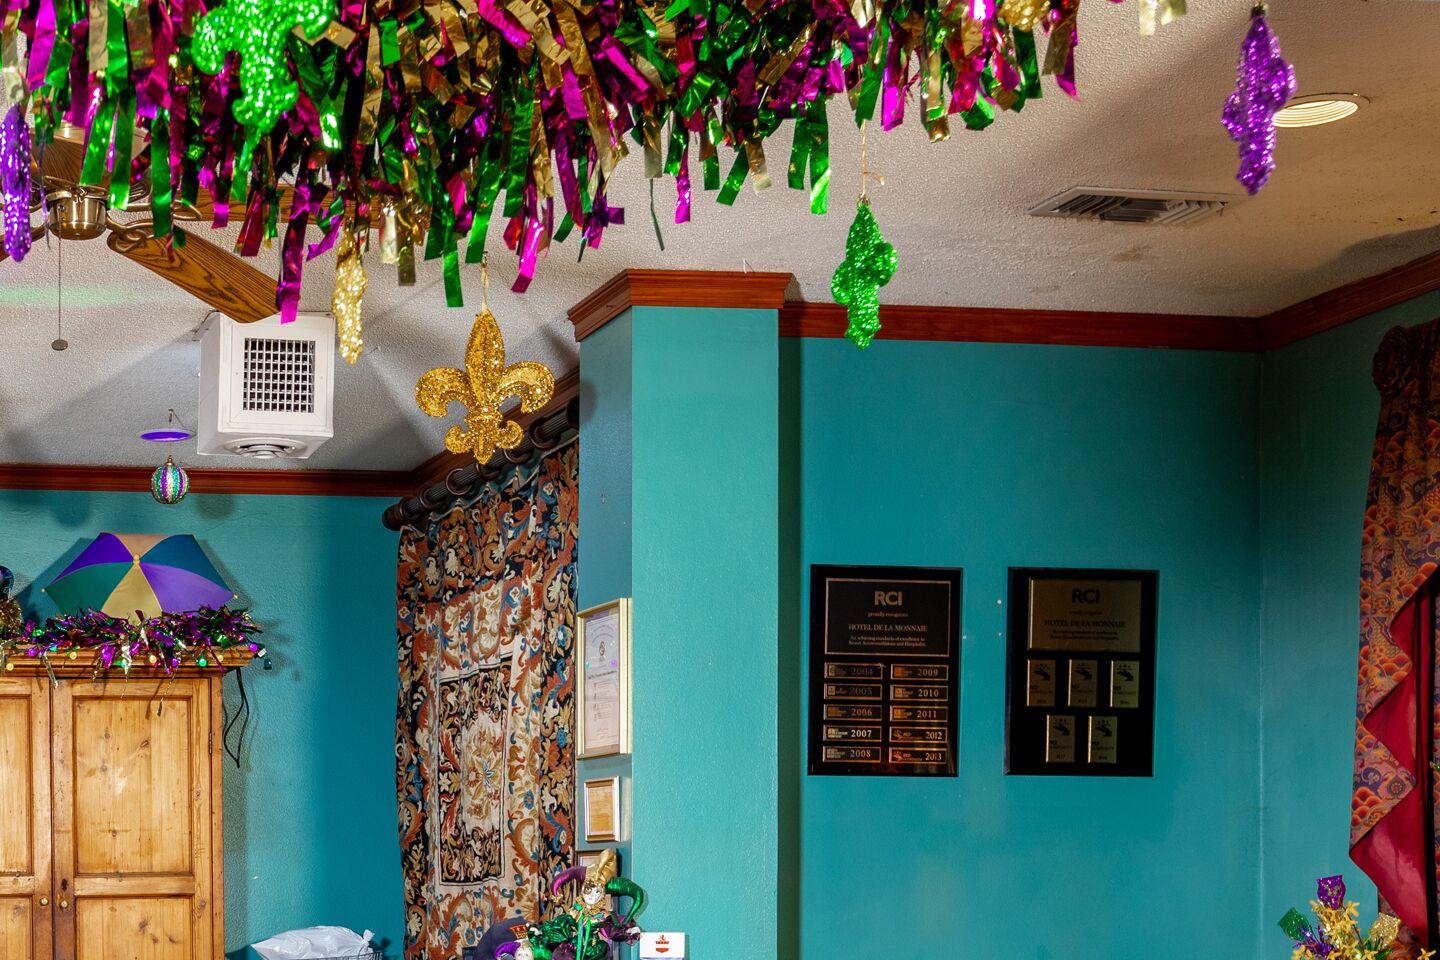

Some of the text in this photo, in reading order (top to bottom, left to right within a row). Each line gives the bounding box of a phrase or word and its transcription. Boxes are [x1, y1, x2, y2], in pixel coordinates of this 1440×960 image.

[874, 590, 903, 606] RCI
[1072, 589, 1100, 604] RCI
[848, 623, 873, 631] HOTEL
[894, 624, 928, 632] MONNAIE
[917, 668, 939, 677] 2009
[918, 688, 939, 697] 2010
[851, 708, 872, 717] 2006
[916, 710, 937, 718] 2011
[851, 729, 872, 738] 2007
[925, 731, 942, 740] 2012
[850, 749, 871, 758] 2008
[925, 752, 942, 761] 2013
